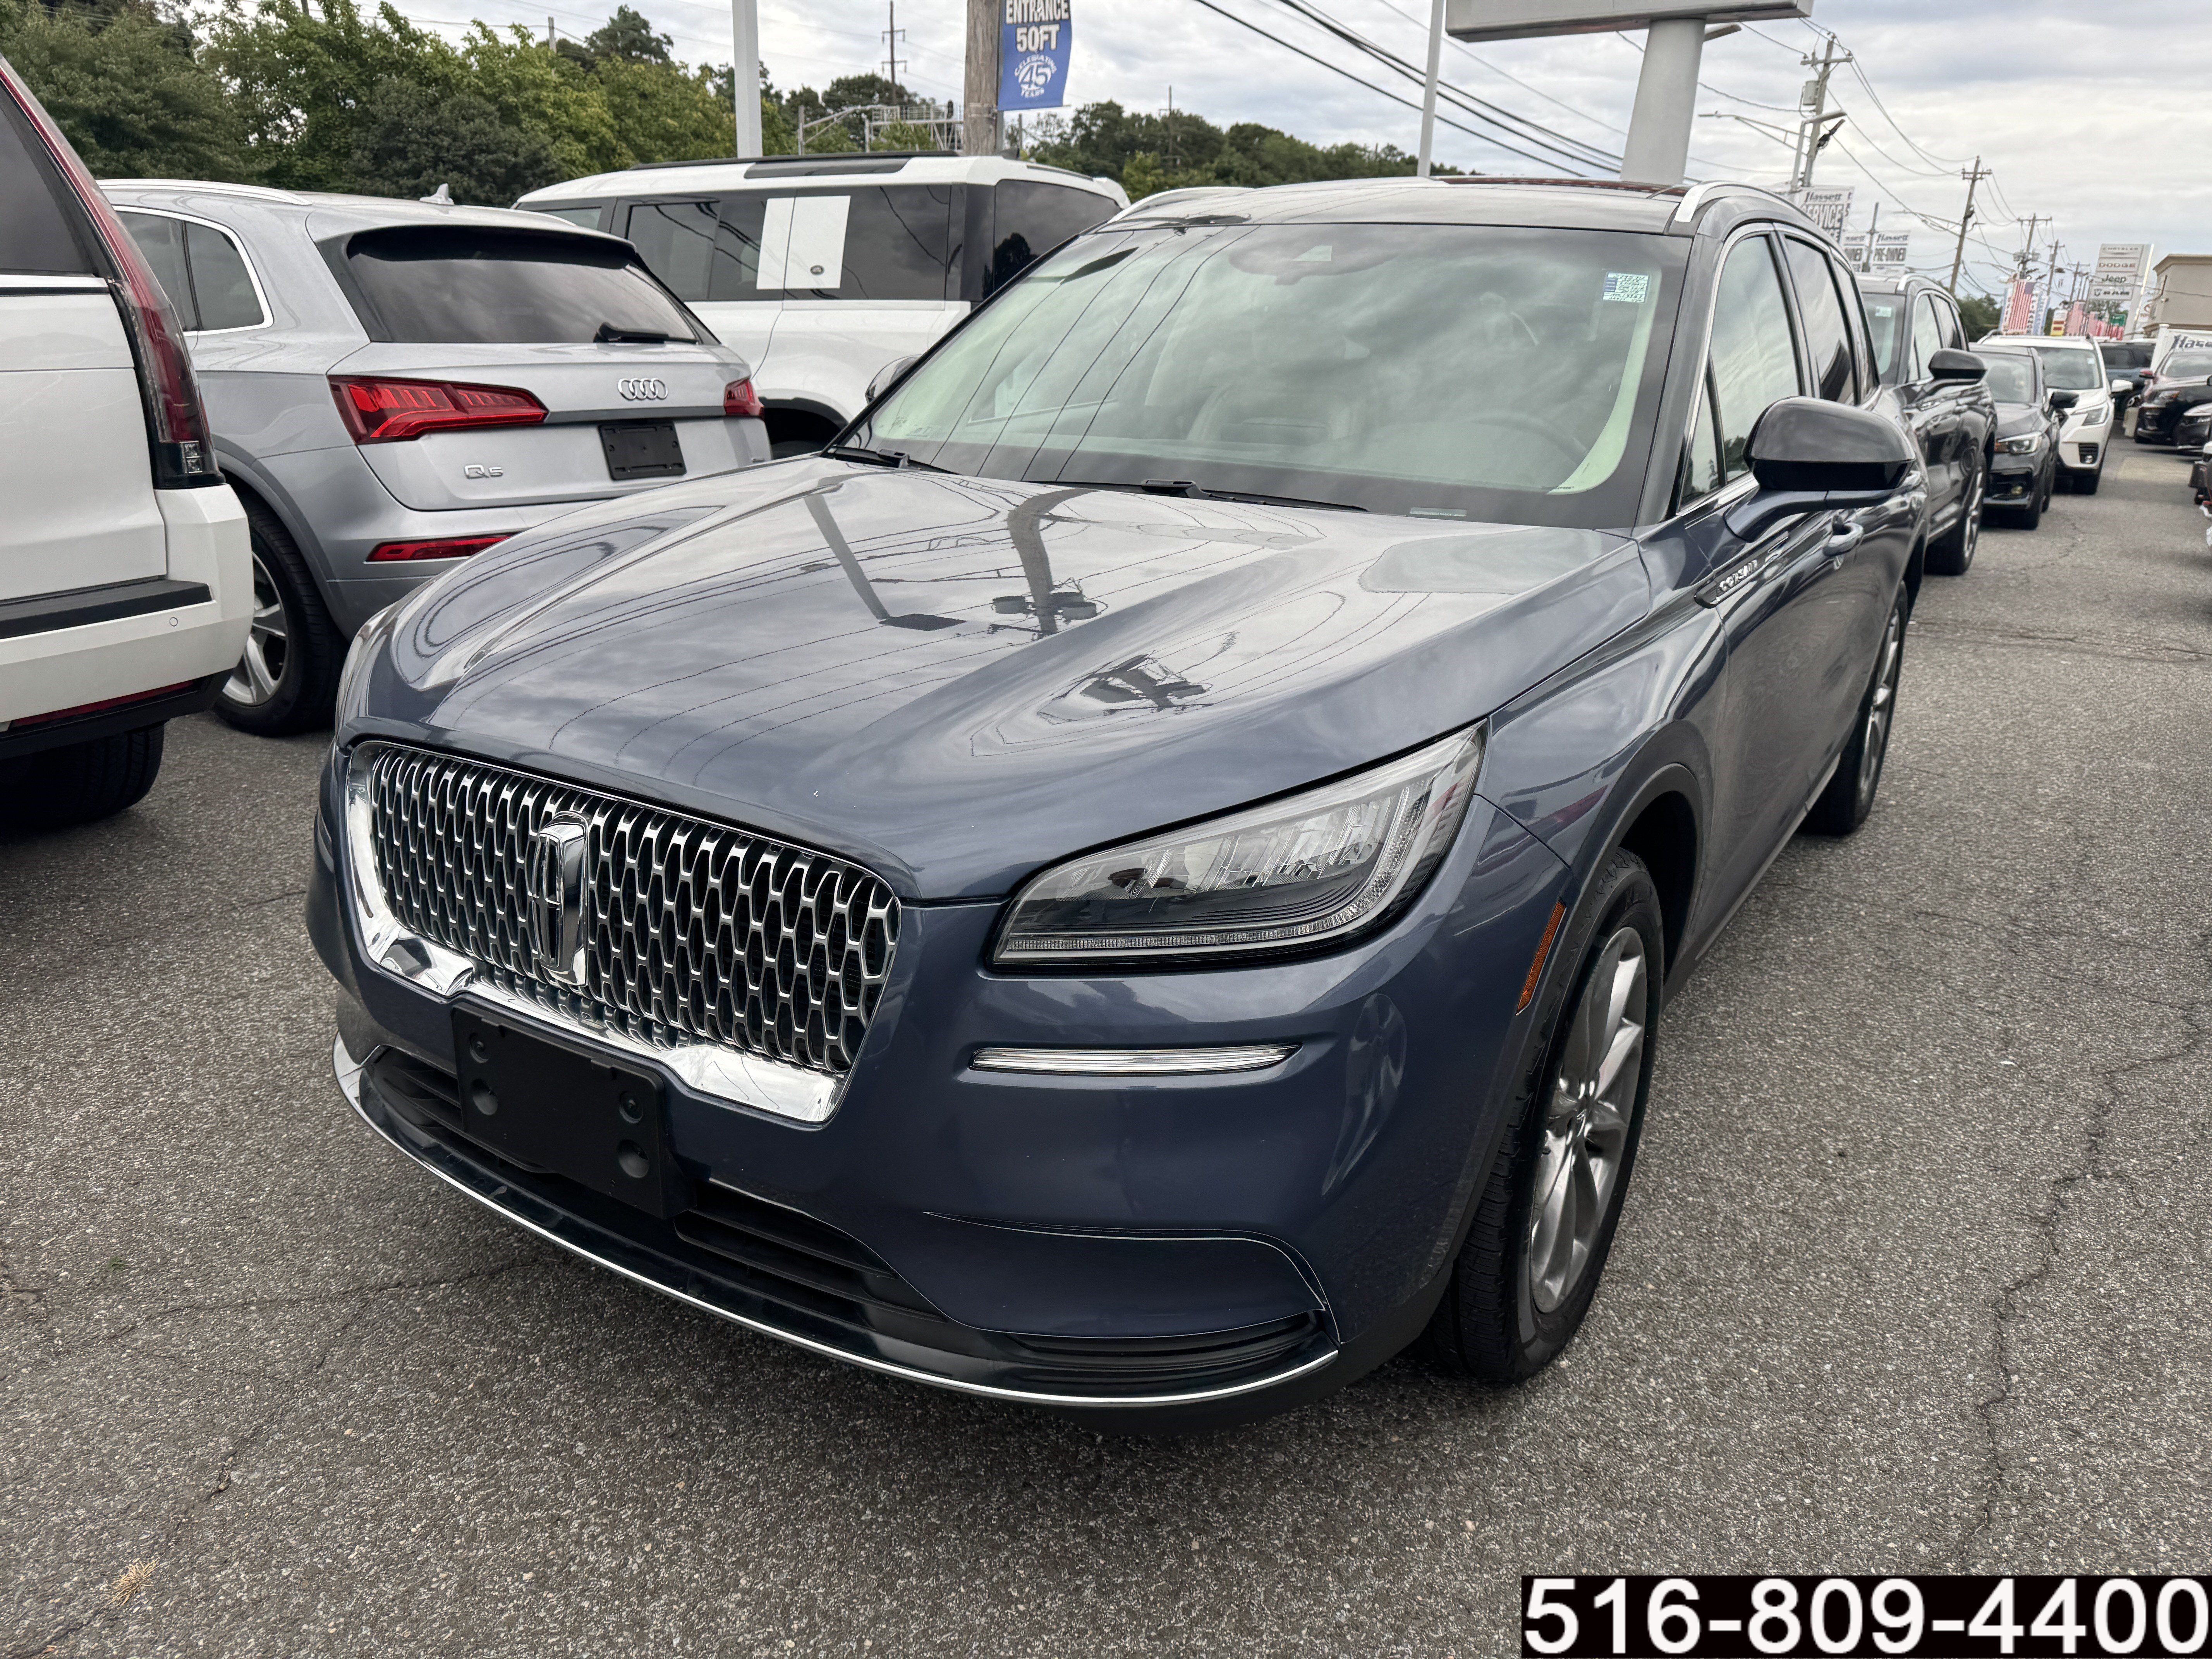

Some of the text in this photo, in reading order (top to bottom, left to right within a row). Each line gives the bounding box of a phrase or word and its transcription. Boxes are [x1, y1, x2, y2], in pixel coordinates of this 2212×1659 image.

[1006, 0, 1070, 24] ENTRANCE
[1015, 24, 1060, 53] 50FT
[1018, 61, 1051, 86] 45
[2101, 274, 2126, 283] Jeep
[464, 464, 503, 479] Q5
